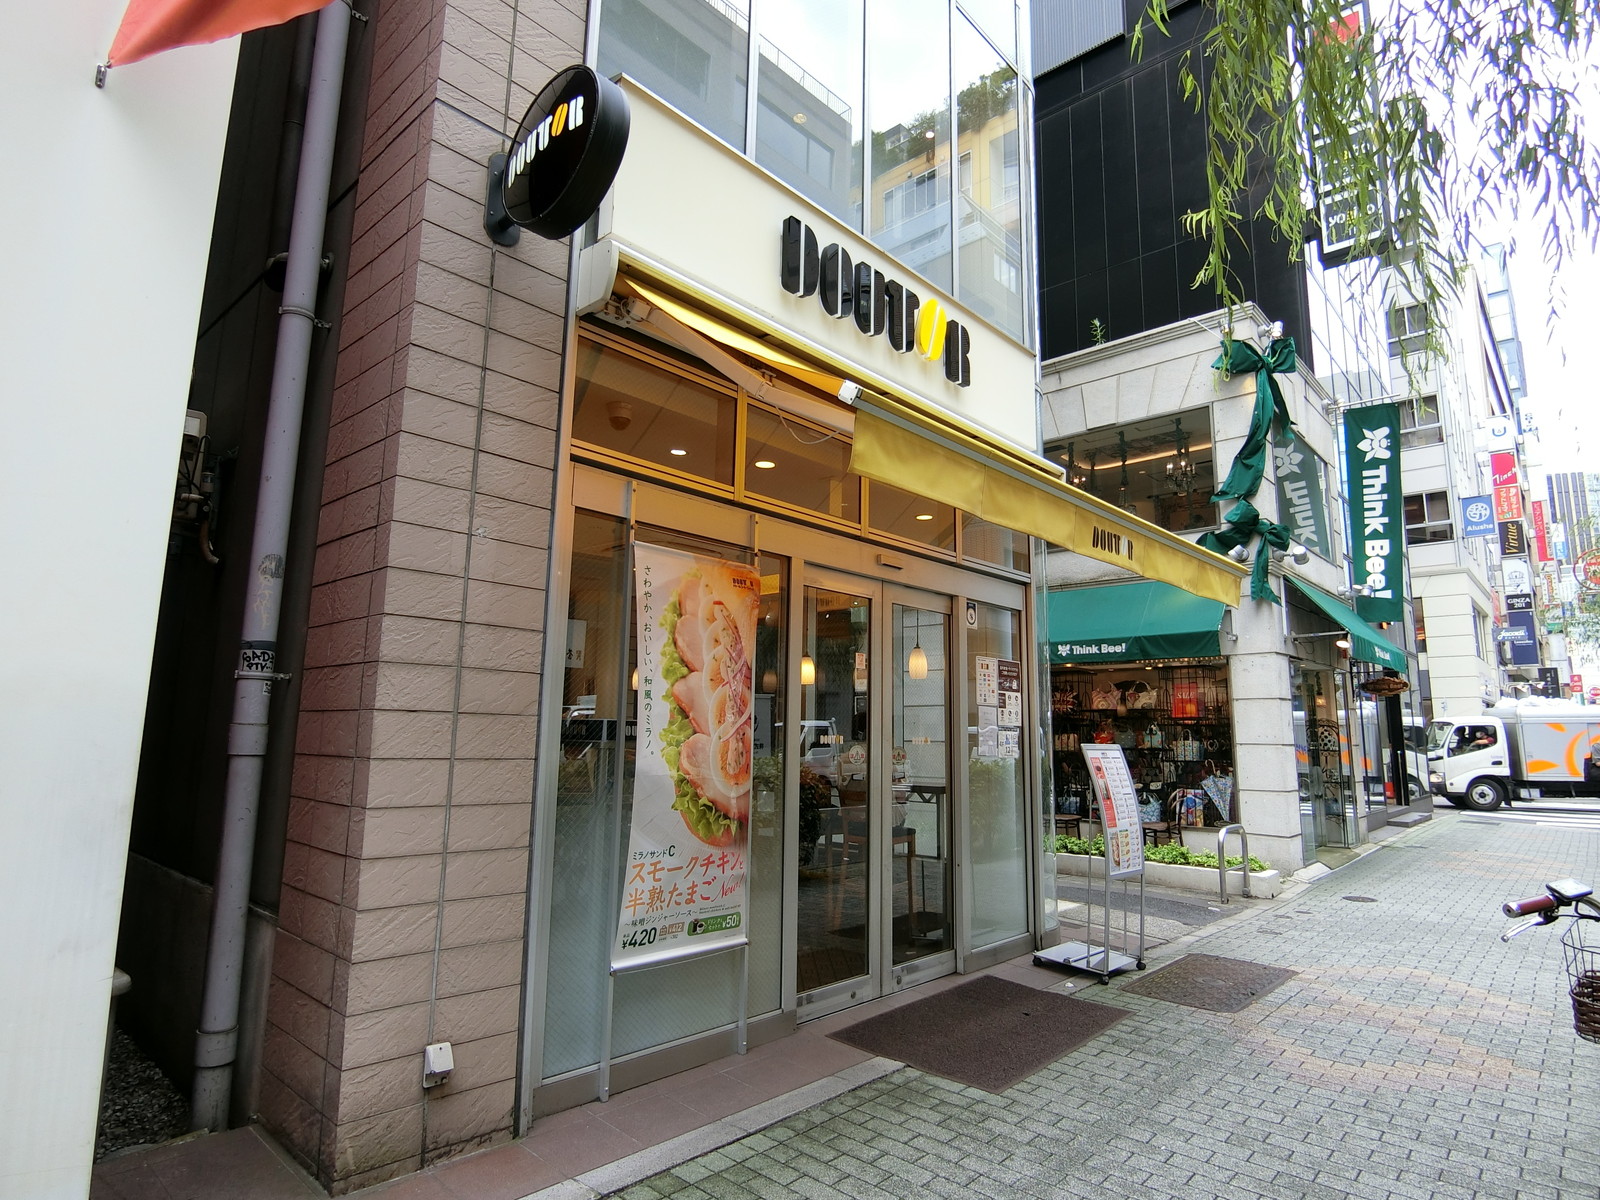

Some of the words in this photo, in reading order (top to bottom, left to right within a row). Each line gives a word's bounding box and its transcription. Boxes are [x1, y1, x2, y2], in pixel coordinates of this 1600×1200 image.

[508, 96, 584, 188] DOUTOR
[780, 215, 971, 388] DOUTOR
[1362, 465, 1389, 536] Think
[1092, 526, 1133, 561] DOUTOR
[1505, 523, 1519, 554] Virtue
[1365, 539, 1392, 599] Bee!
[643, 564, 655, 757] さわやか、おいしい、和風のミラノ。
[1072, 644, 1100, 655] Think
[1101, 643, 1126, 654] Bee!
[625, 876, 717, 917] 半熟たまご
[621, 927, 658, 950] ¥420
